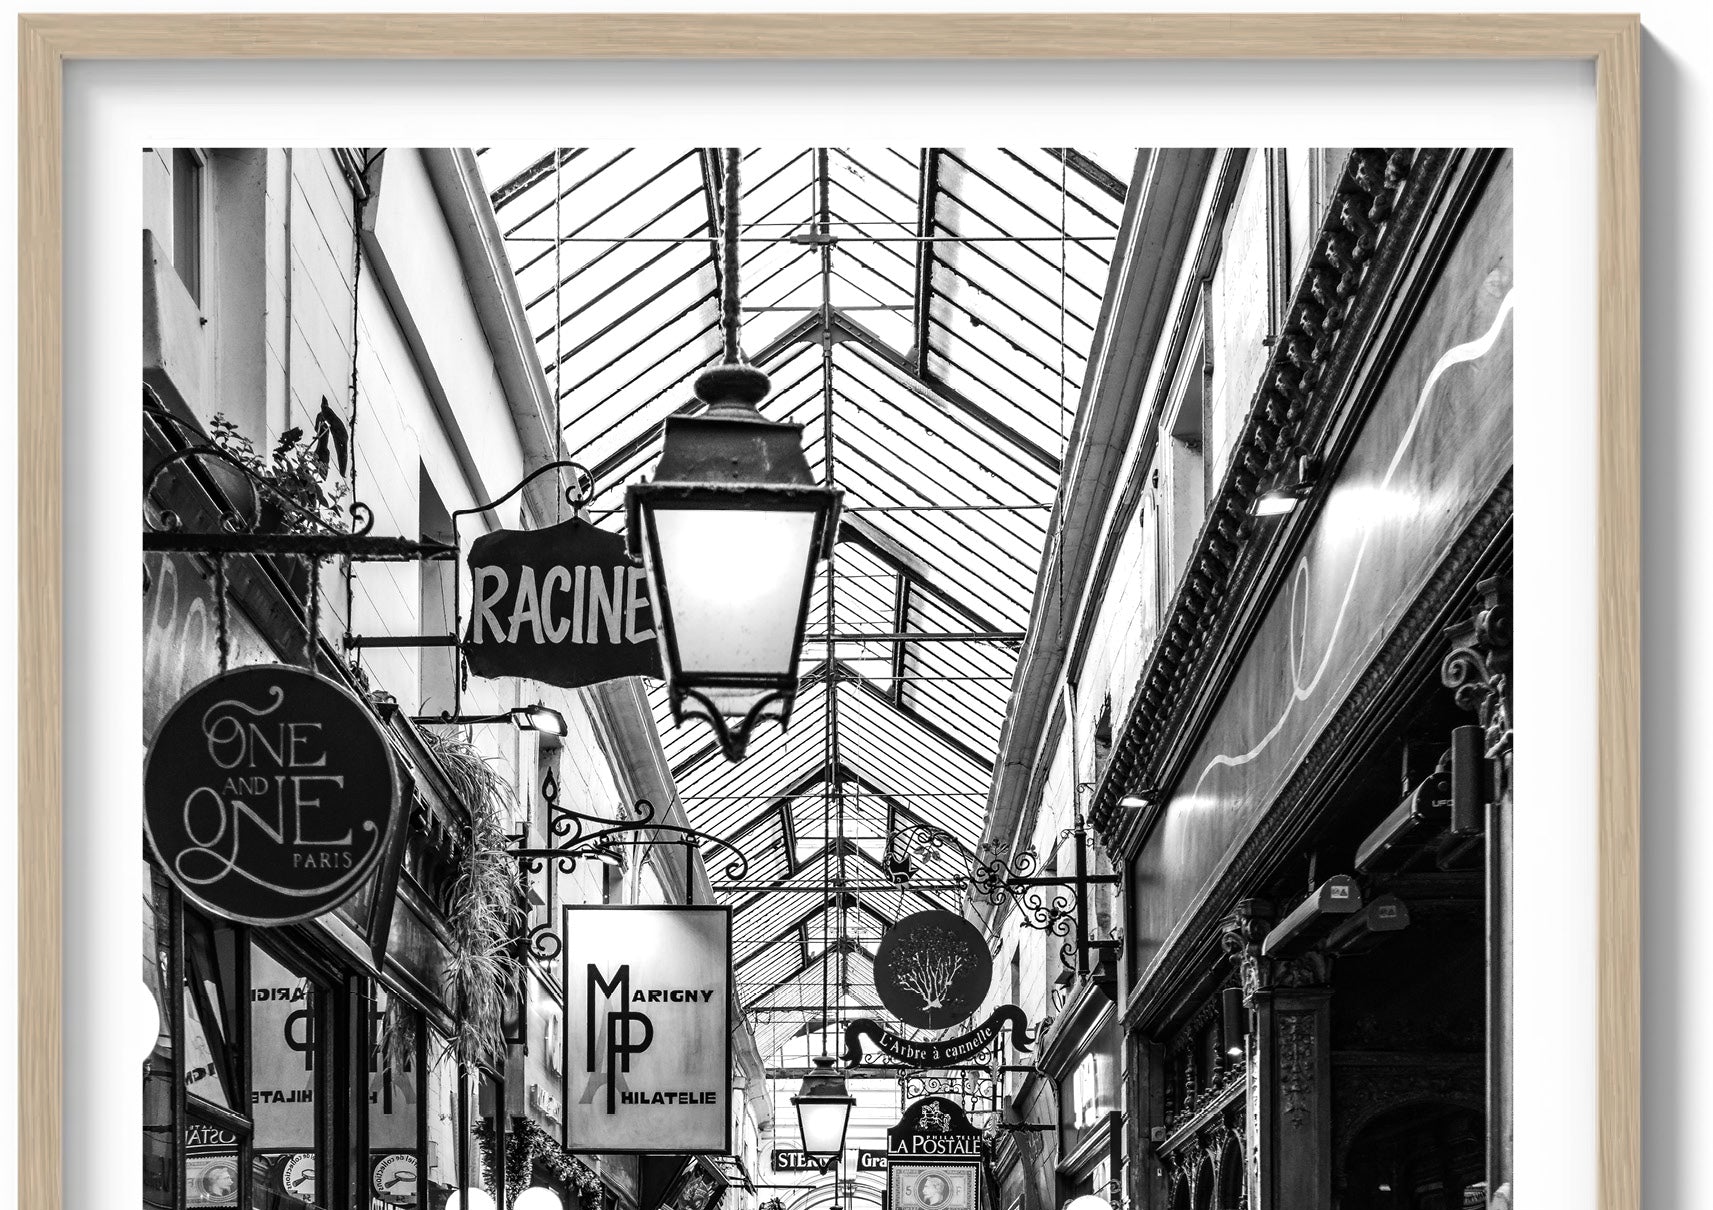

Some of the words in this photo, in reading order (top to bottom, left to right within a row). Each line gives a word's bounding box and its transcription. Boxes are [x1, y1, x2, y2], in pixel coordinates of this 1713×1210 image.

[473, 565, 657, 645] RACINE
[203, 685, 326, 769] ONE
[222, 776, 269, 796] AND
[175, 775, 356, 886] ONE
[293, 851, 352, 869] PARIS
[879, 1033, 927, 1060] L'Arbre
[933, 1046, 940, 1060] à
[945, 1027, 993, 1058] cannelle
[888, 1135, 909, 1154] LA
[912, 1135, 981, 1154] POSTALE
